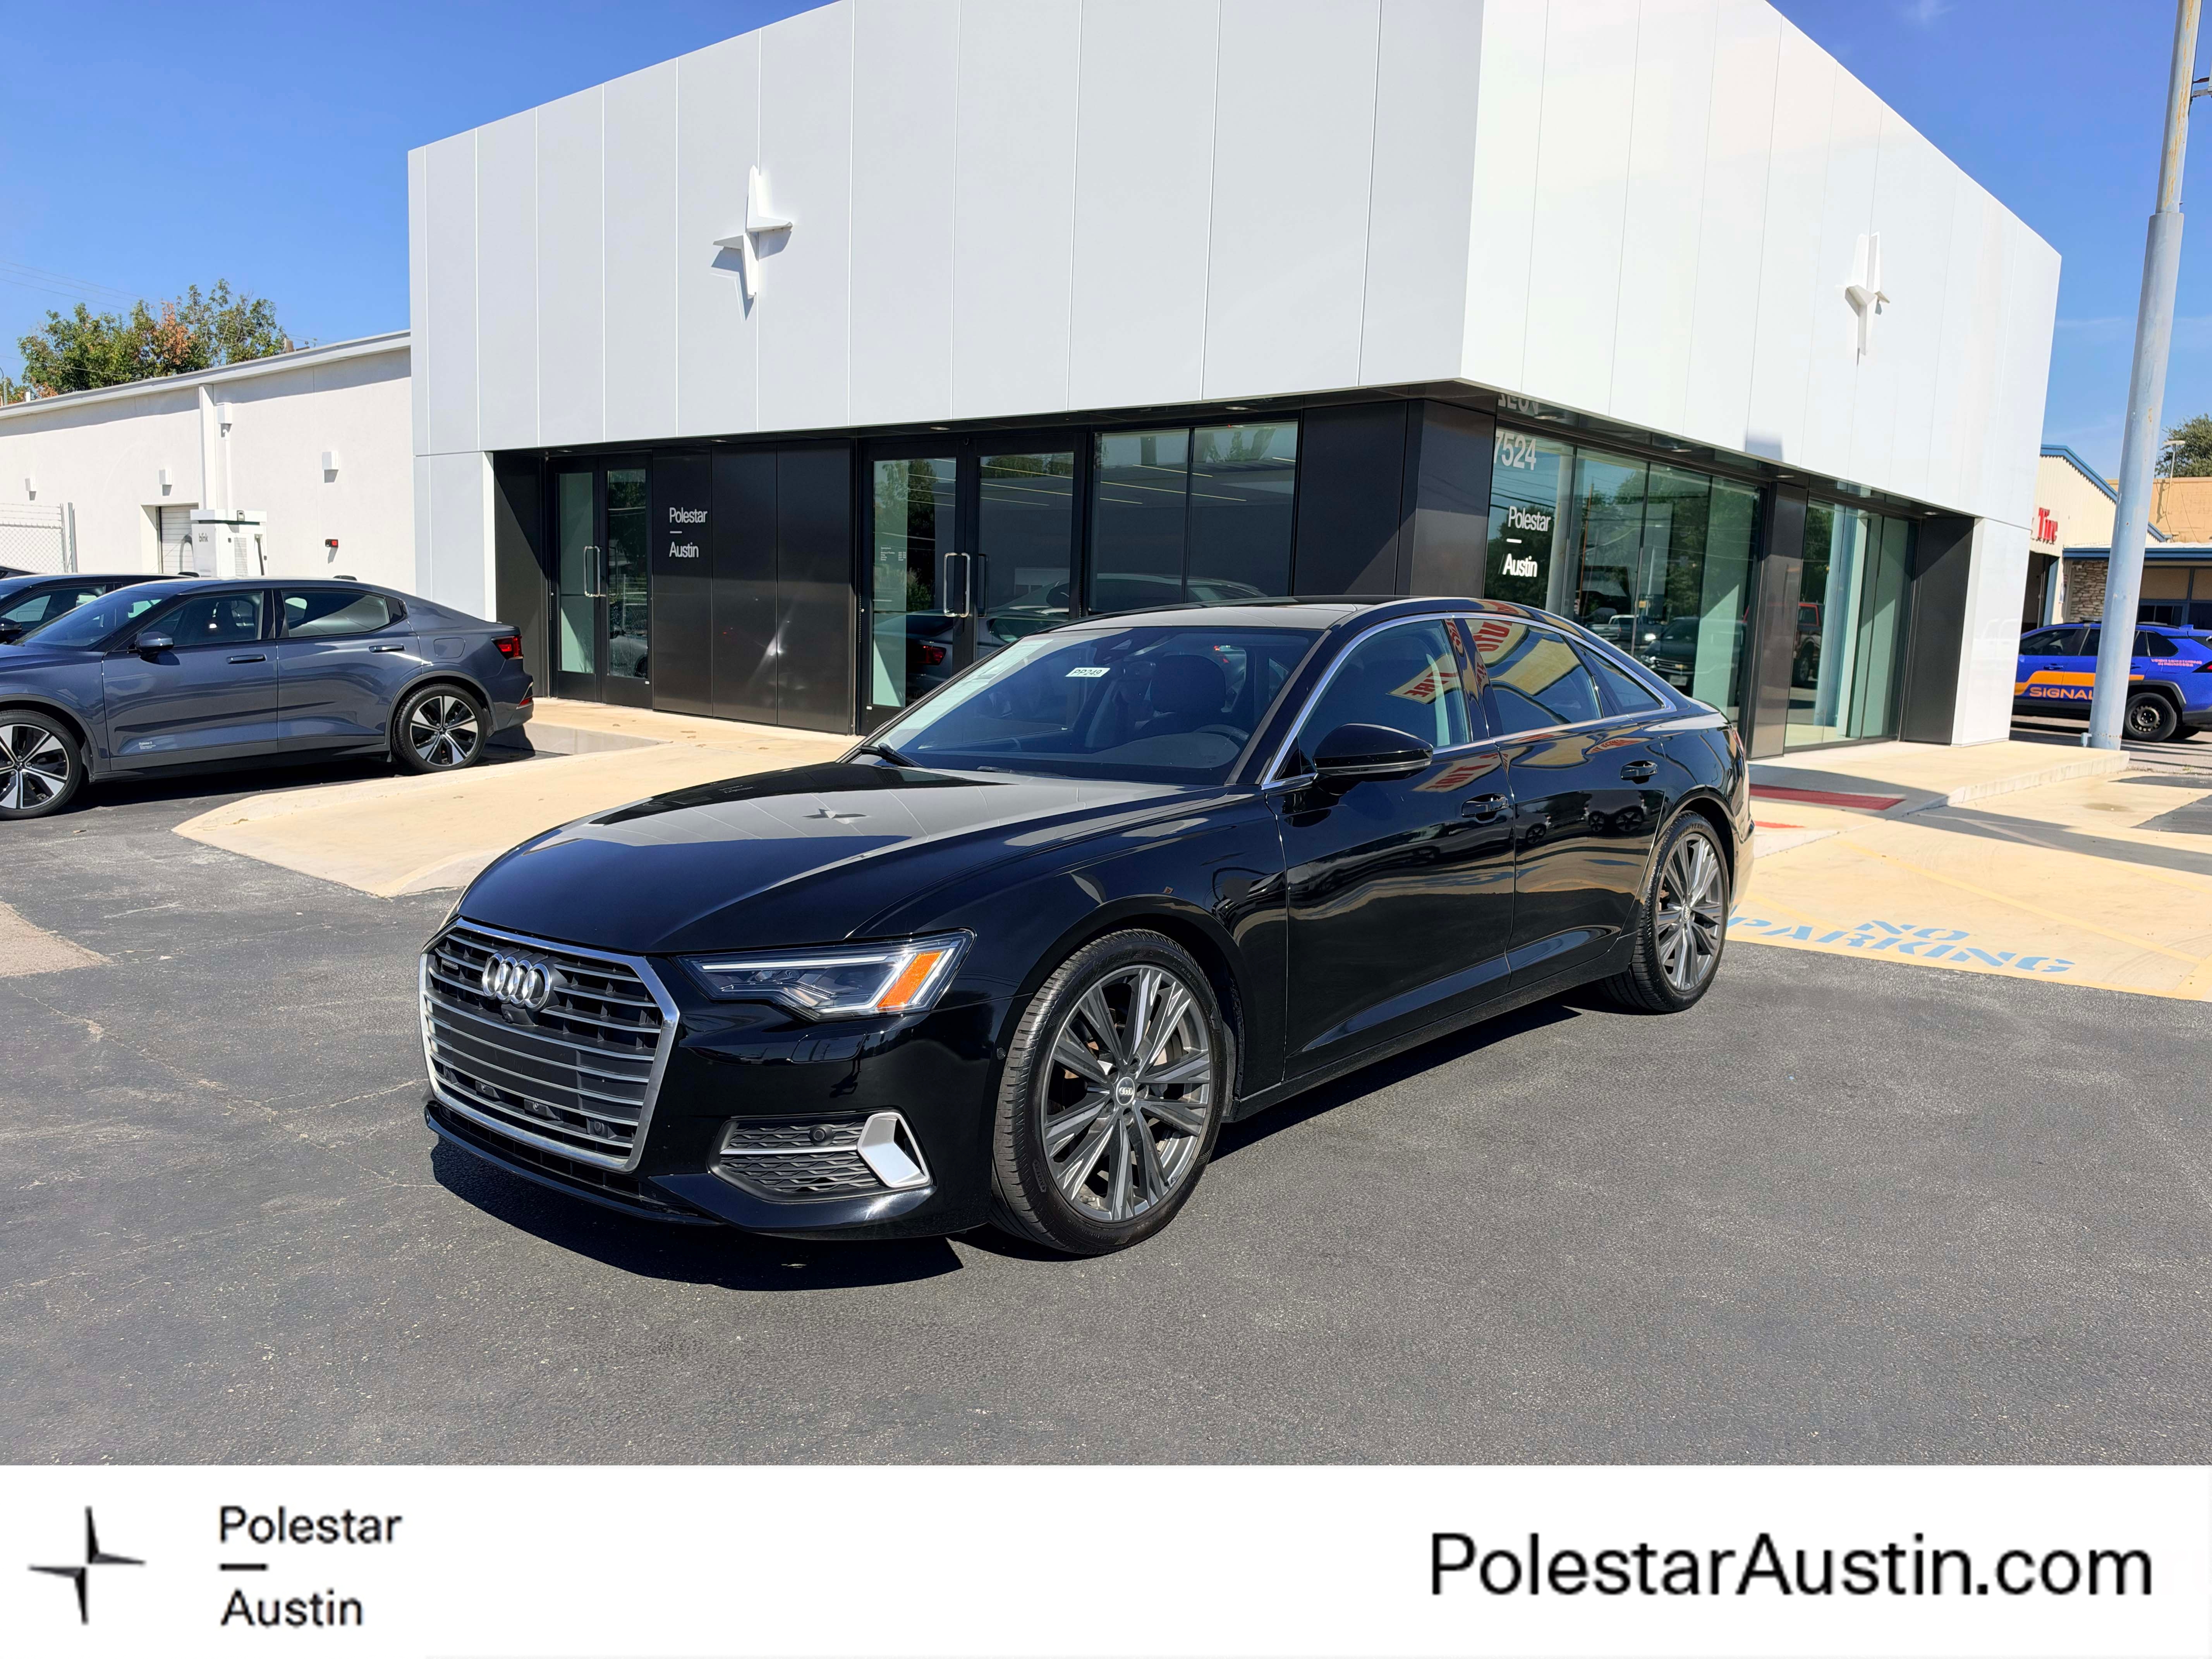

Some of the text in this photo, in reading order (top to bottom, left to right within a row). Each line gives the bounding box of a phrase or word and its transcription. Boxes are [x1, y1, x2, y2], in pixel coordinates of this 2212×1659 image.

[1494, 430, 1537, 470] 7524
[669, 507, 708, 523] Polestar
[1508, 506, 1551, 531] Polestar
[669, 541, 699, 558] Austin
[1502, 553, 1537, 577] Austin
[2029, 687, 2093, 700] SIGNAL
[1853, 920, 1970, 941] NO
[1727, 917, 2075, 972] PARKING
